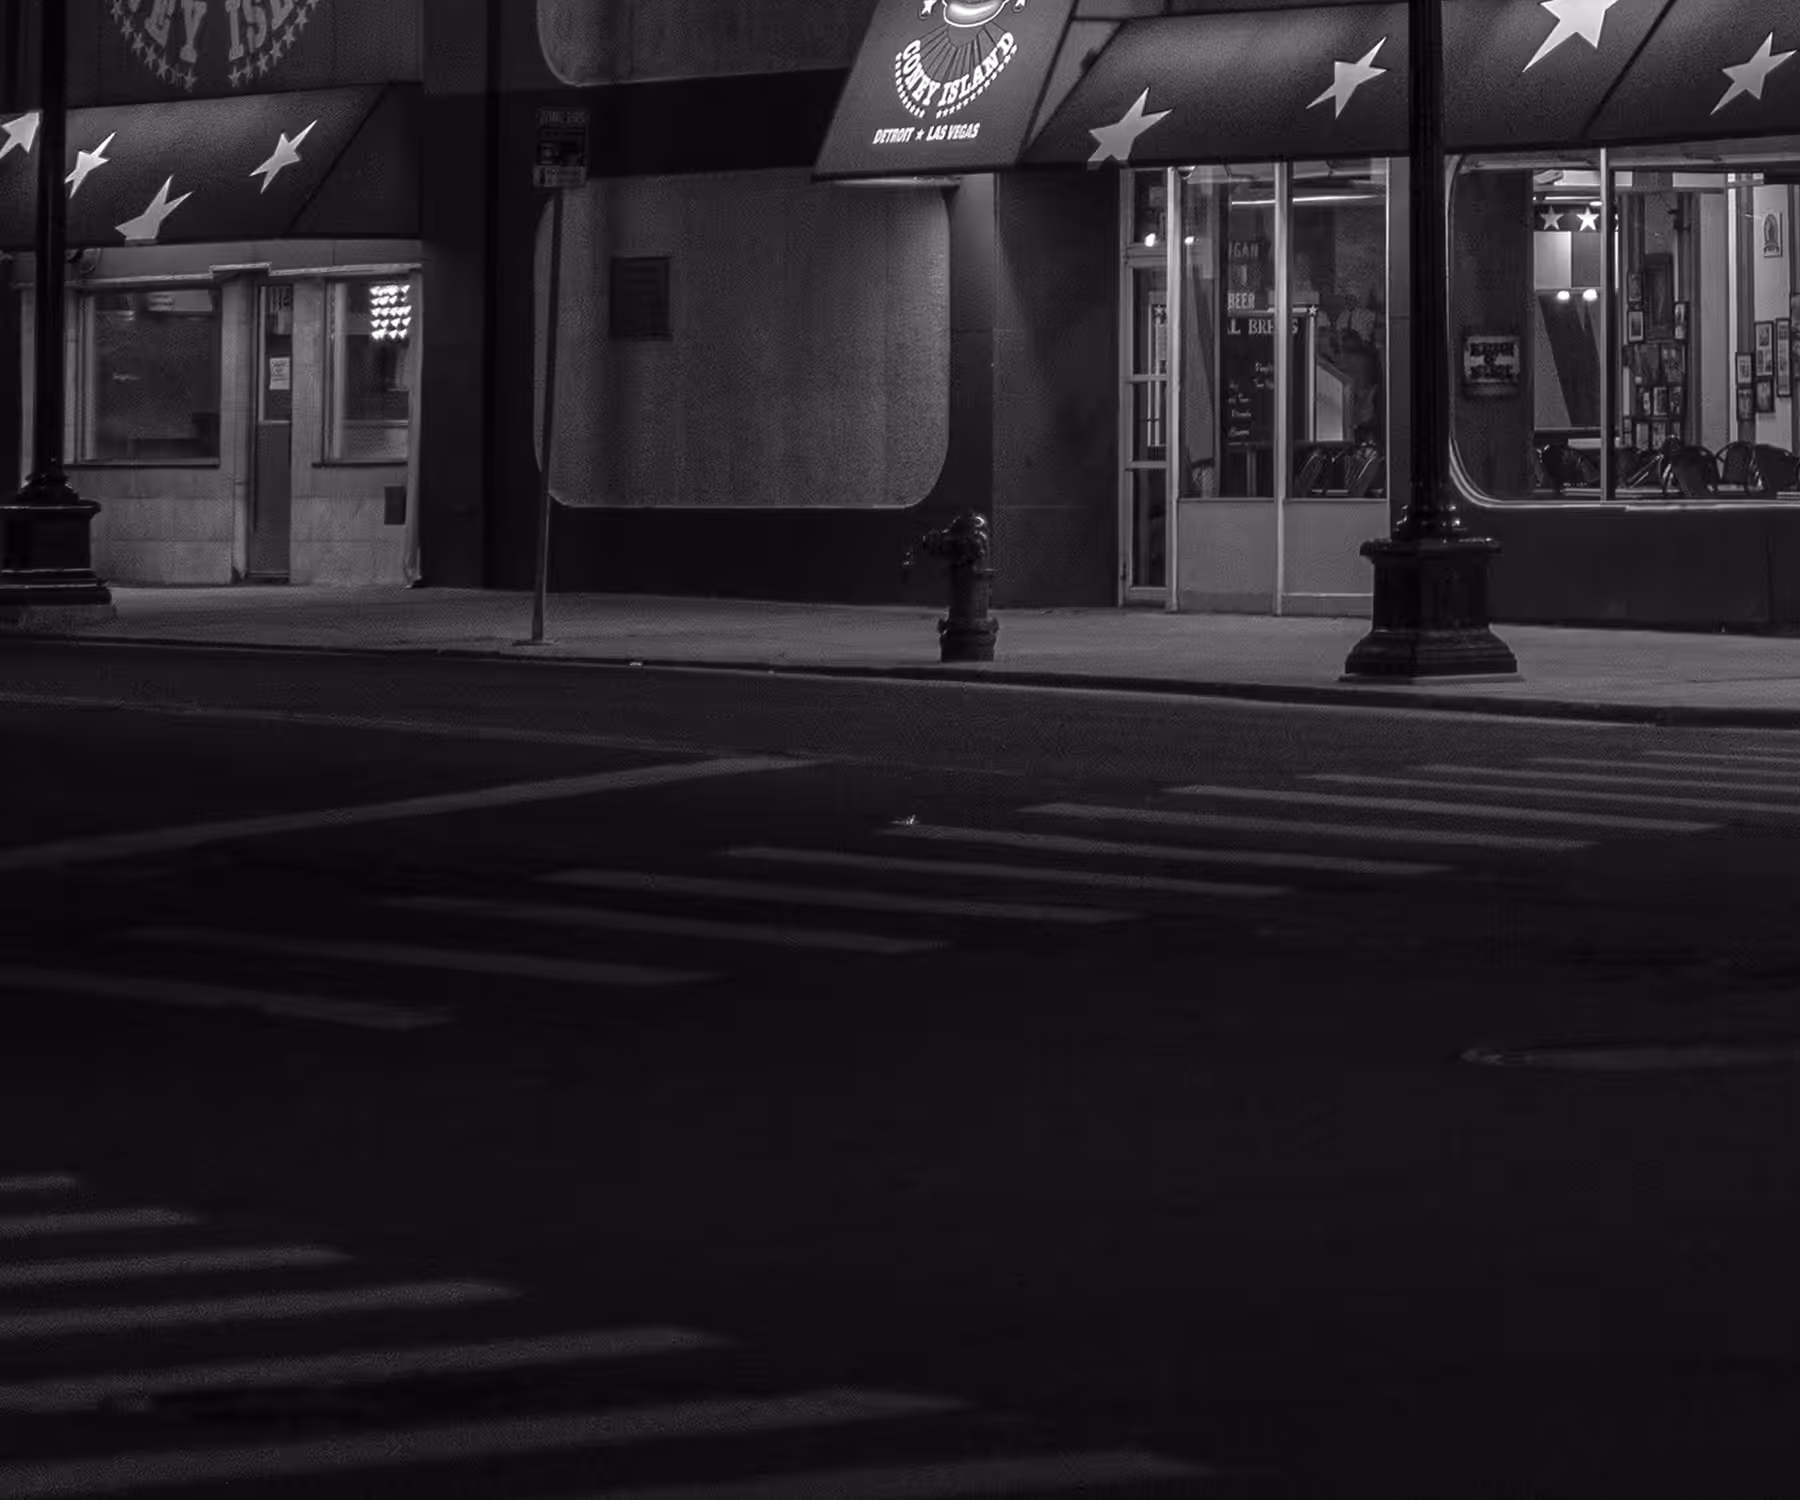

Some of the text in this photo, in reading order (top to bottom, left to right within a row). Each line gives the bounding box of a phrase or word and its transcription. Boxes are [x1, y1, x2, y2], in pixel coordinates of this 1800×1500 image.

[902, 31, 1014, 107] CONEY ISLAND
[872, 122, 980, 144] DETROIT LAS VEGAS
